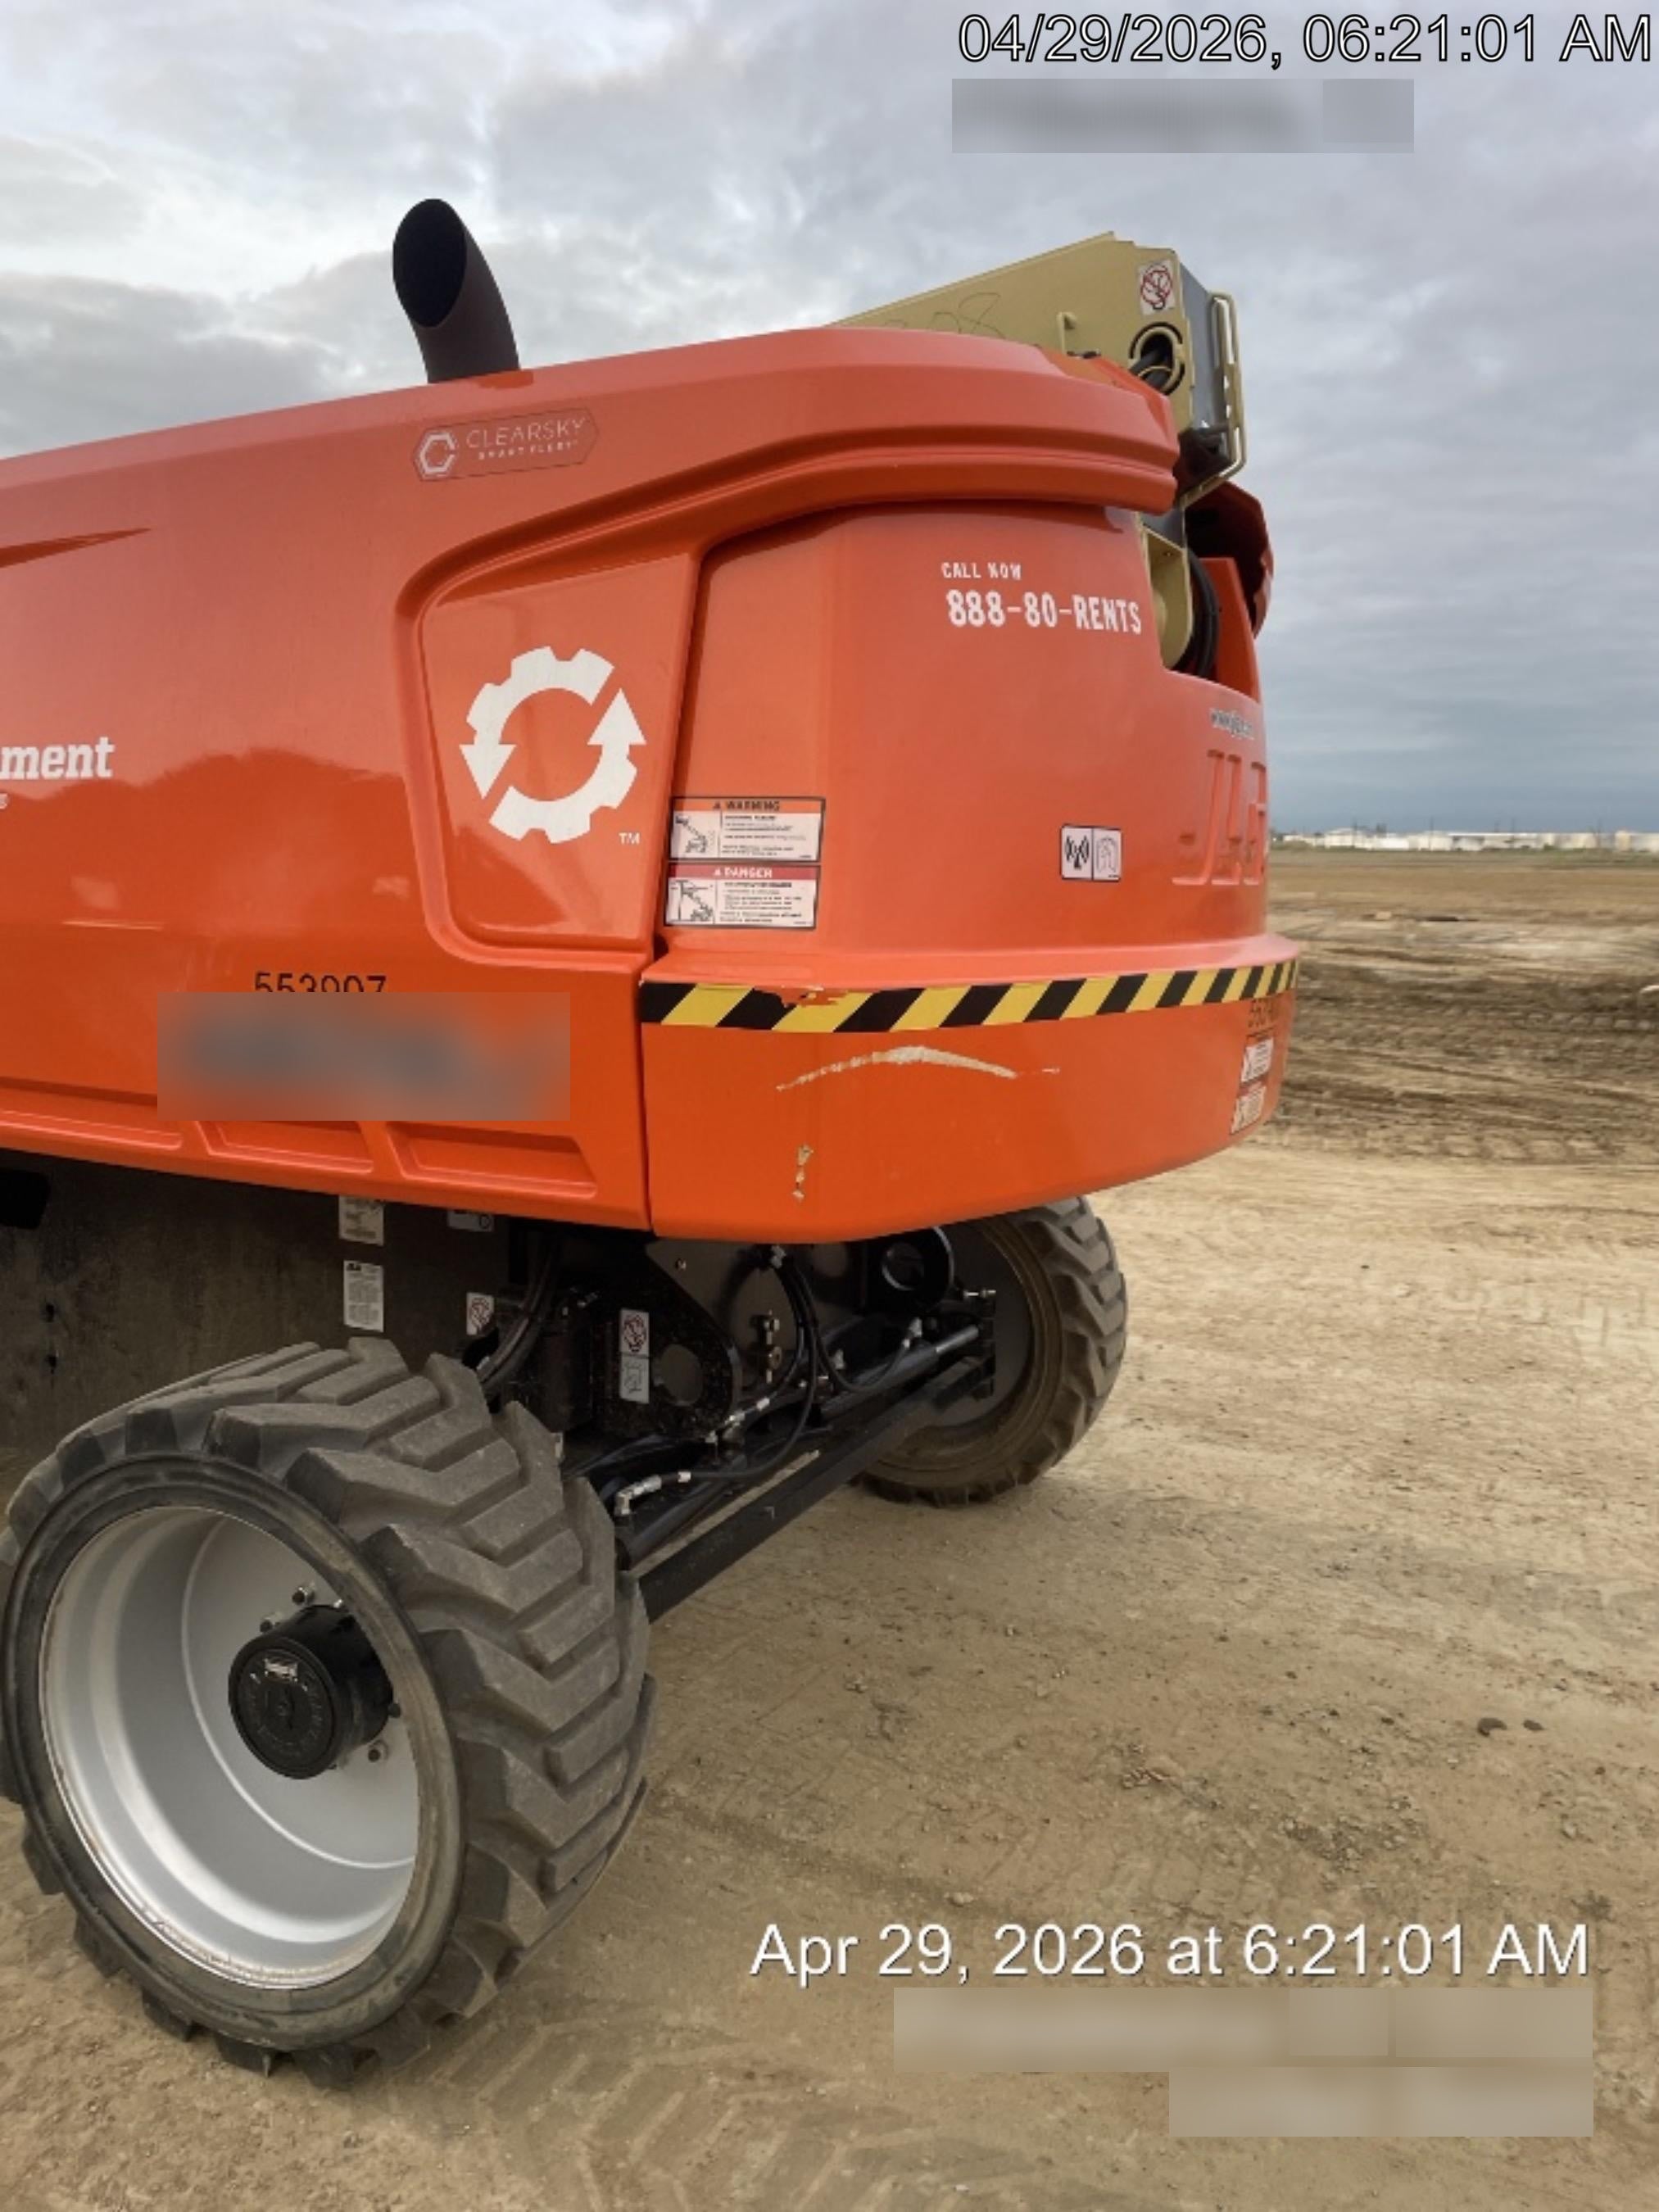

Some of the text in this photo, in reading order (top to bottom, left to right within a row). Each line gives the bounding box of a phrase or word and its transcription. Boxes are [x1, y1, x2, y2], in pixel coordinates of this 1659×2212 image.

[465, 417, 587, 448] CLEARSKY
[942, 562, 1022, 580] CALL NOW
[945, 589, 1142, 635] 888-80-RENTS
[726, 800, 780, 812] WARNING
[619, 832, 641, 845] TM
[724, 867, 773, 878] DANGER
